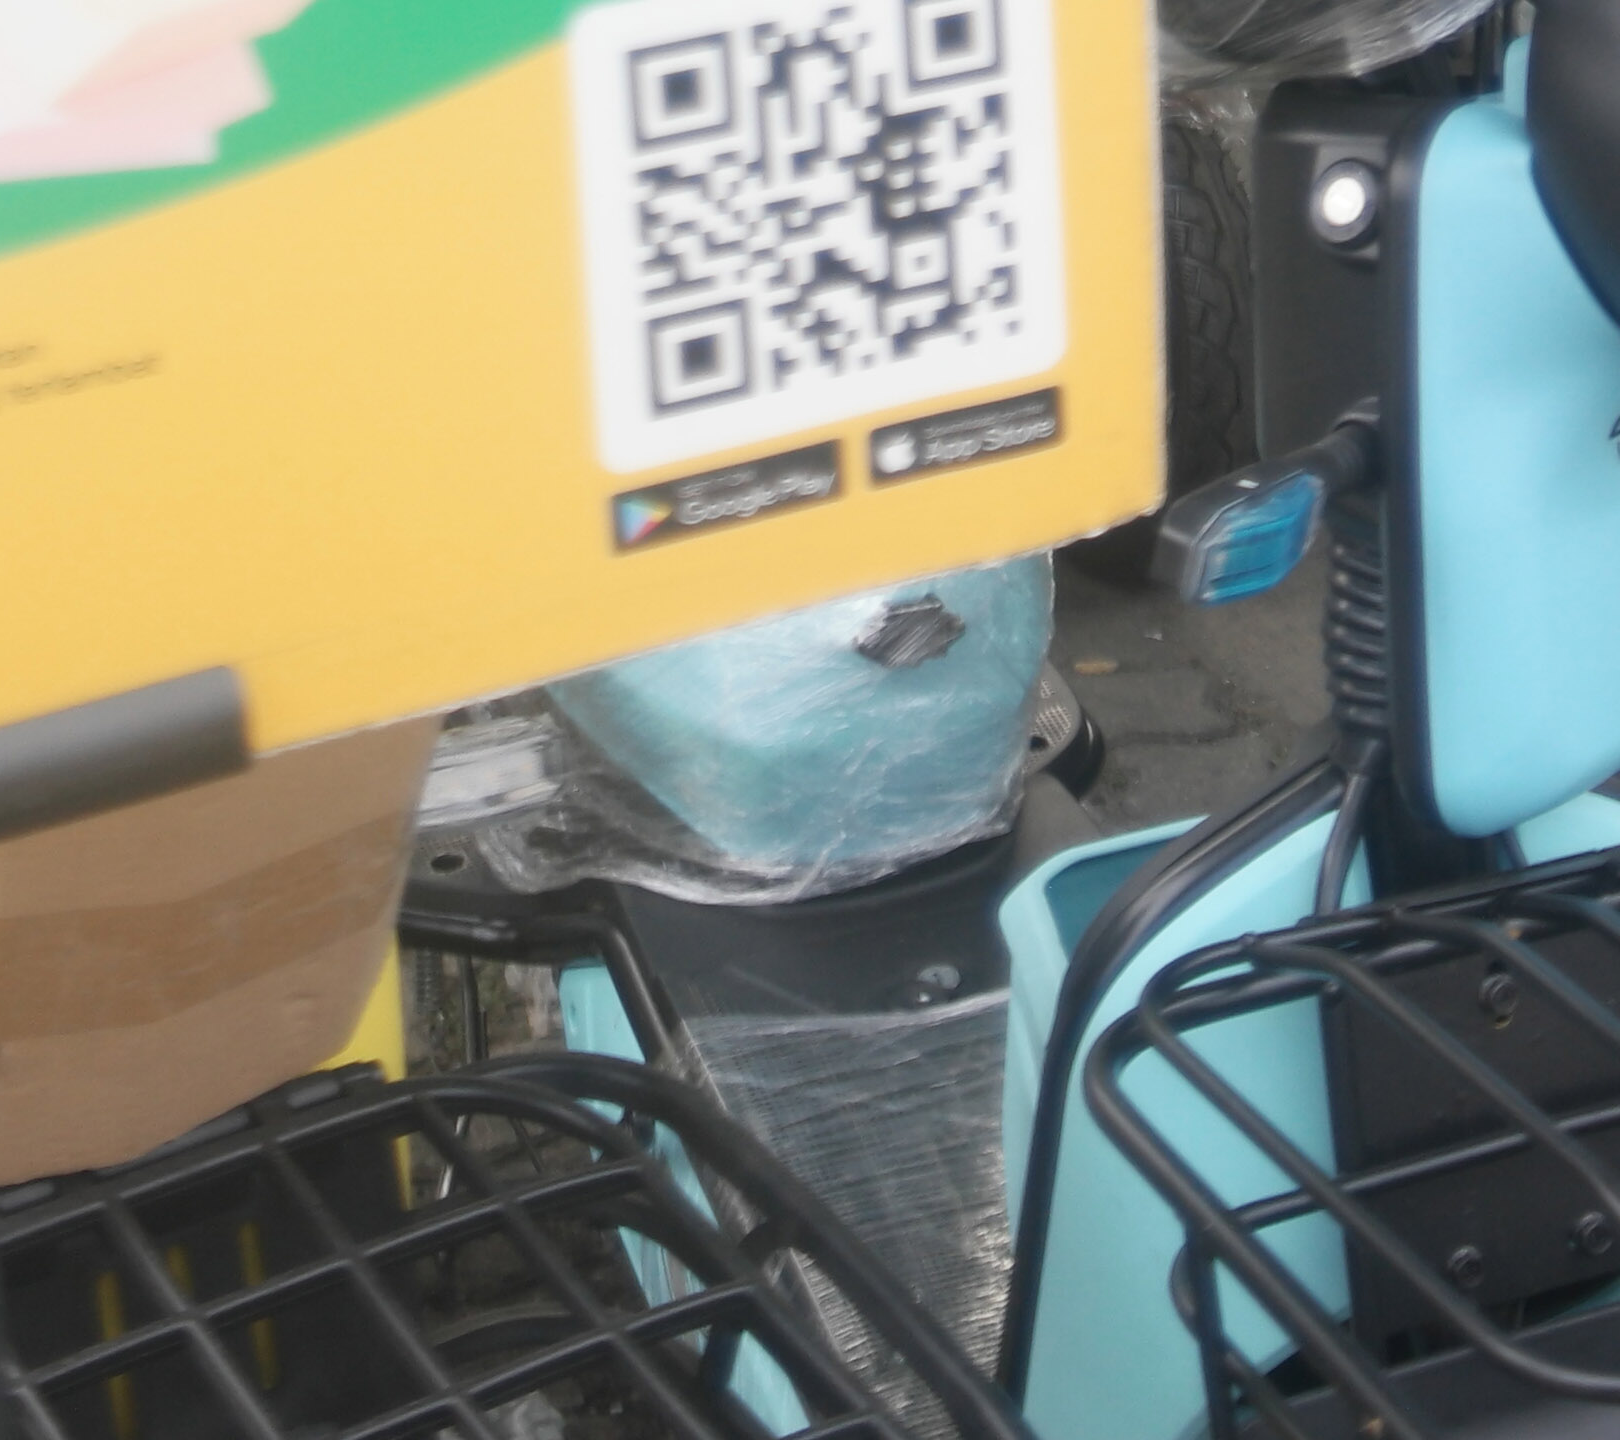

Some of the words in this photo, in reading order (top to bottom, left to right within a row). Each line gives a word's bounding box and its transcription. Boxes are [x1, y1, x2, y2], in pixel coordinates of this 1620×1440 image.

[982, 416, 1055, 452] Store
[680, 484, 778, 526] Google
[779, 469, 837, 498] Play
